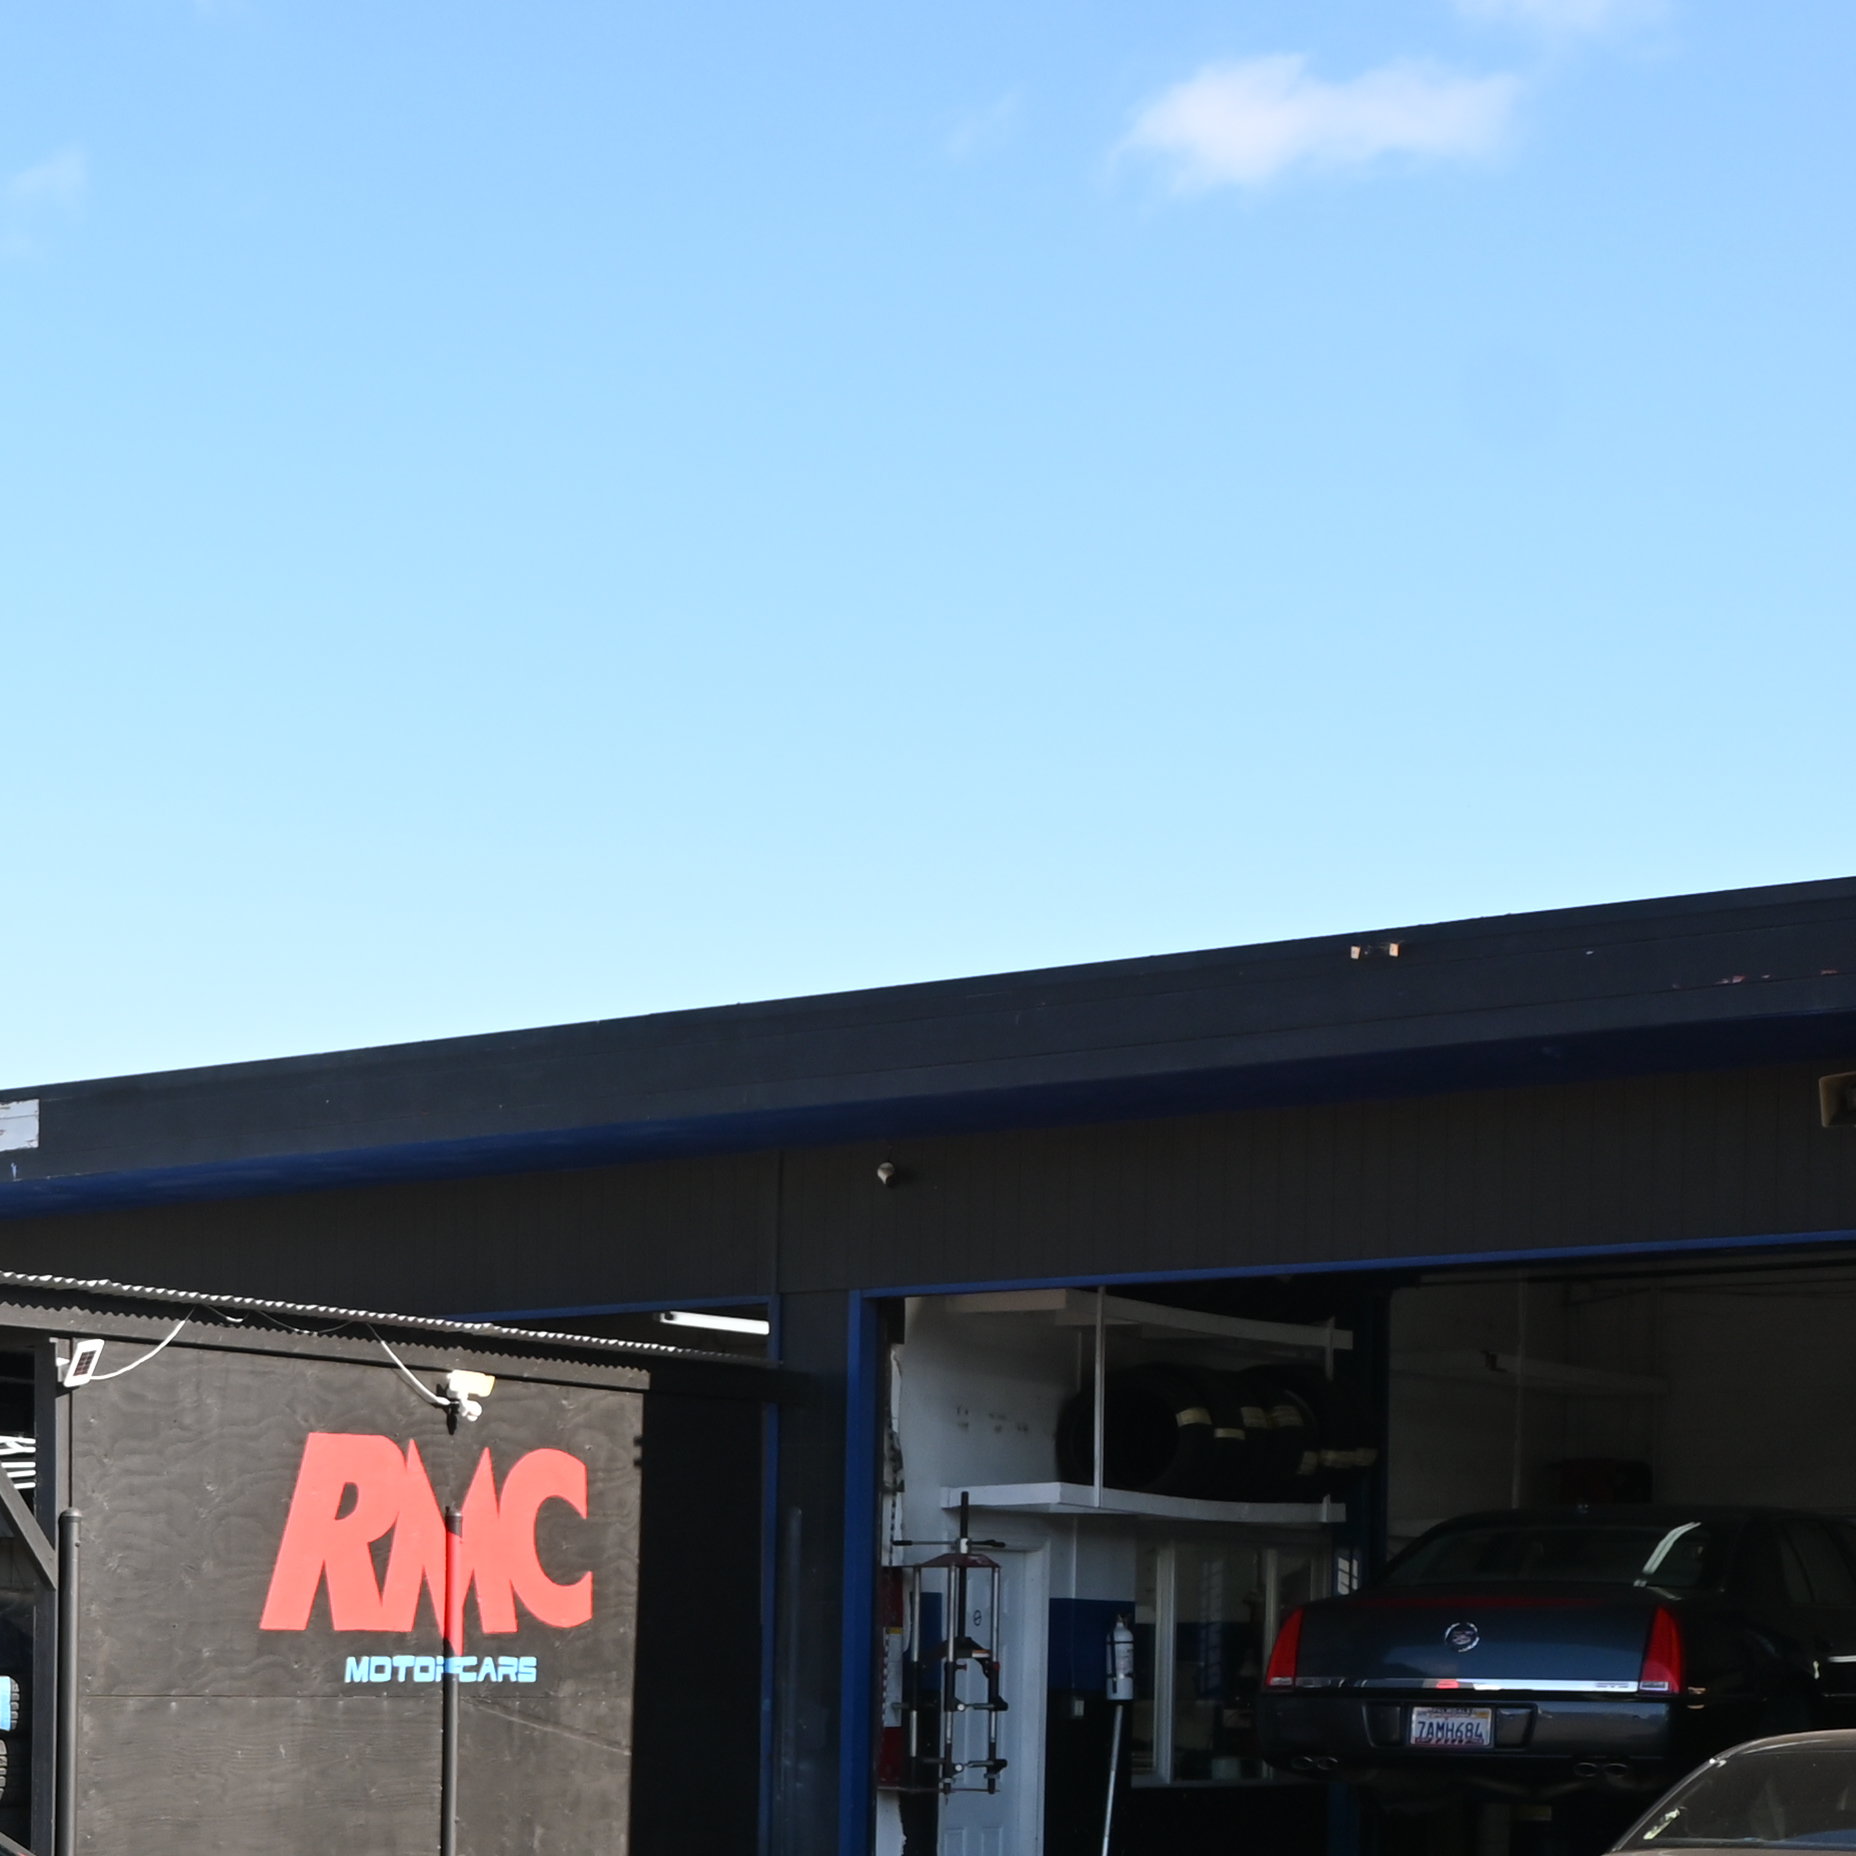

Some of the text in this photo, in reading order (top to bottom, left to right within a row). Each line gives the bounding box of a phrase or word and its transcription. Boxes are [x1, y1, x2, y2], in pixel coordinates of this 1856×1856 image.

[260, 1432, 593, 1645] RMC
[344, 1655, 537, 1684] MOTORCARS
[1418, 1721, 1483, 1739] 7AMH684
